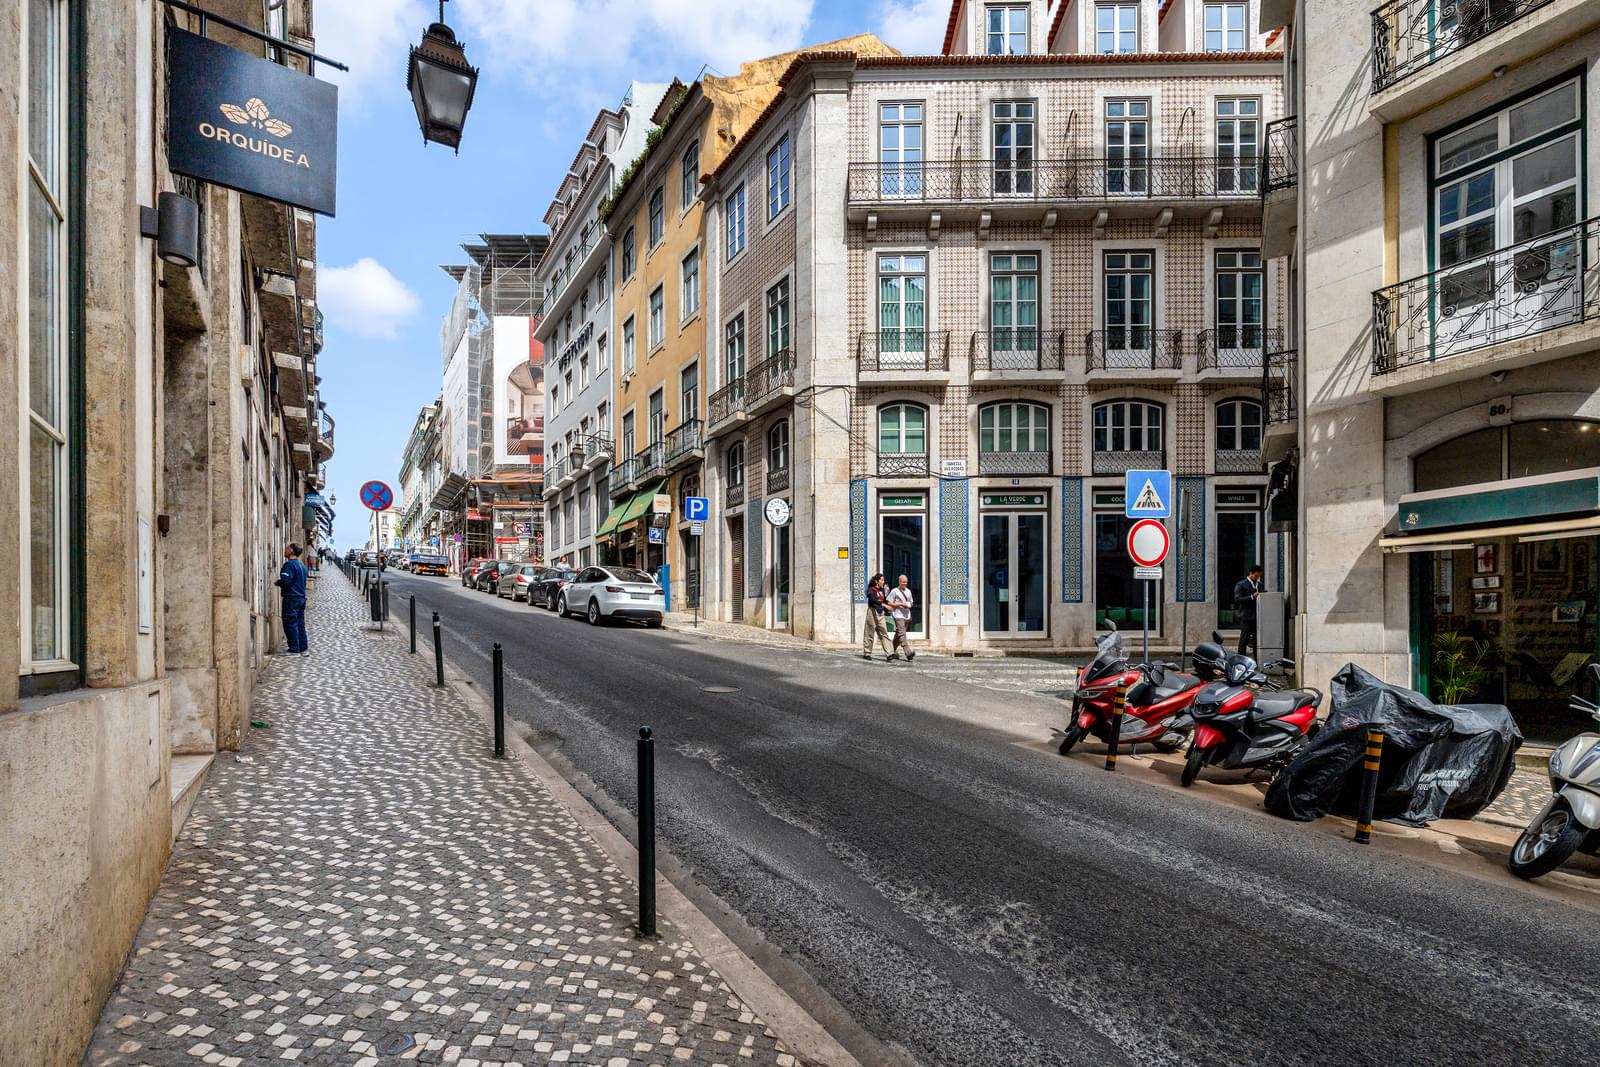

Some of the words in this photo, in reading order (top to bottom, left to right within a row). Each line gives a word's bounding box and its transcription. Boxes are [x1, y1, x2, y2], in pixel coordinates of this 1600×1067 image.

[199, 122, 310, 168] ORQUÍDEA
[1489, 404, 1506, 416] 80
[691, 499, 704, 519] P
